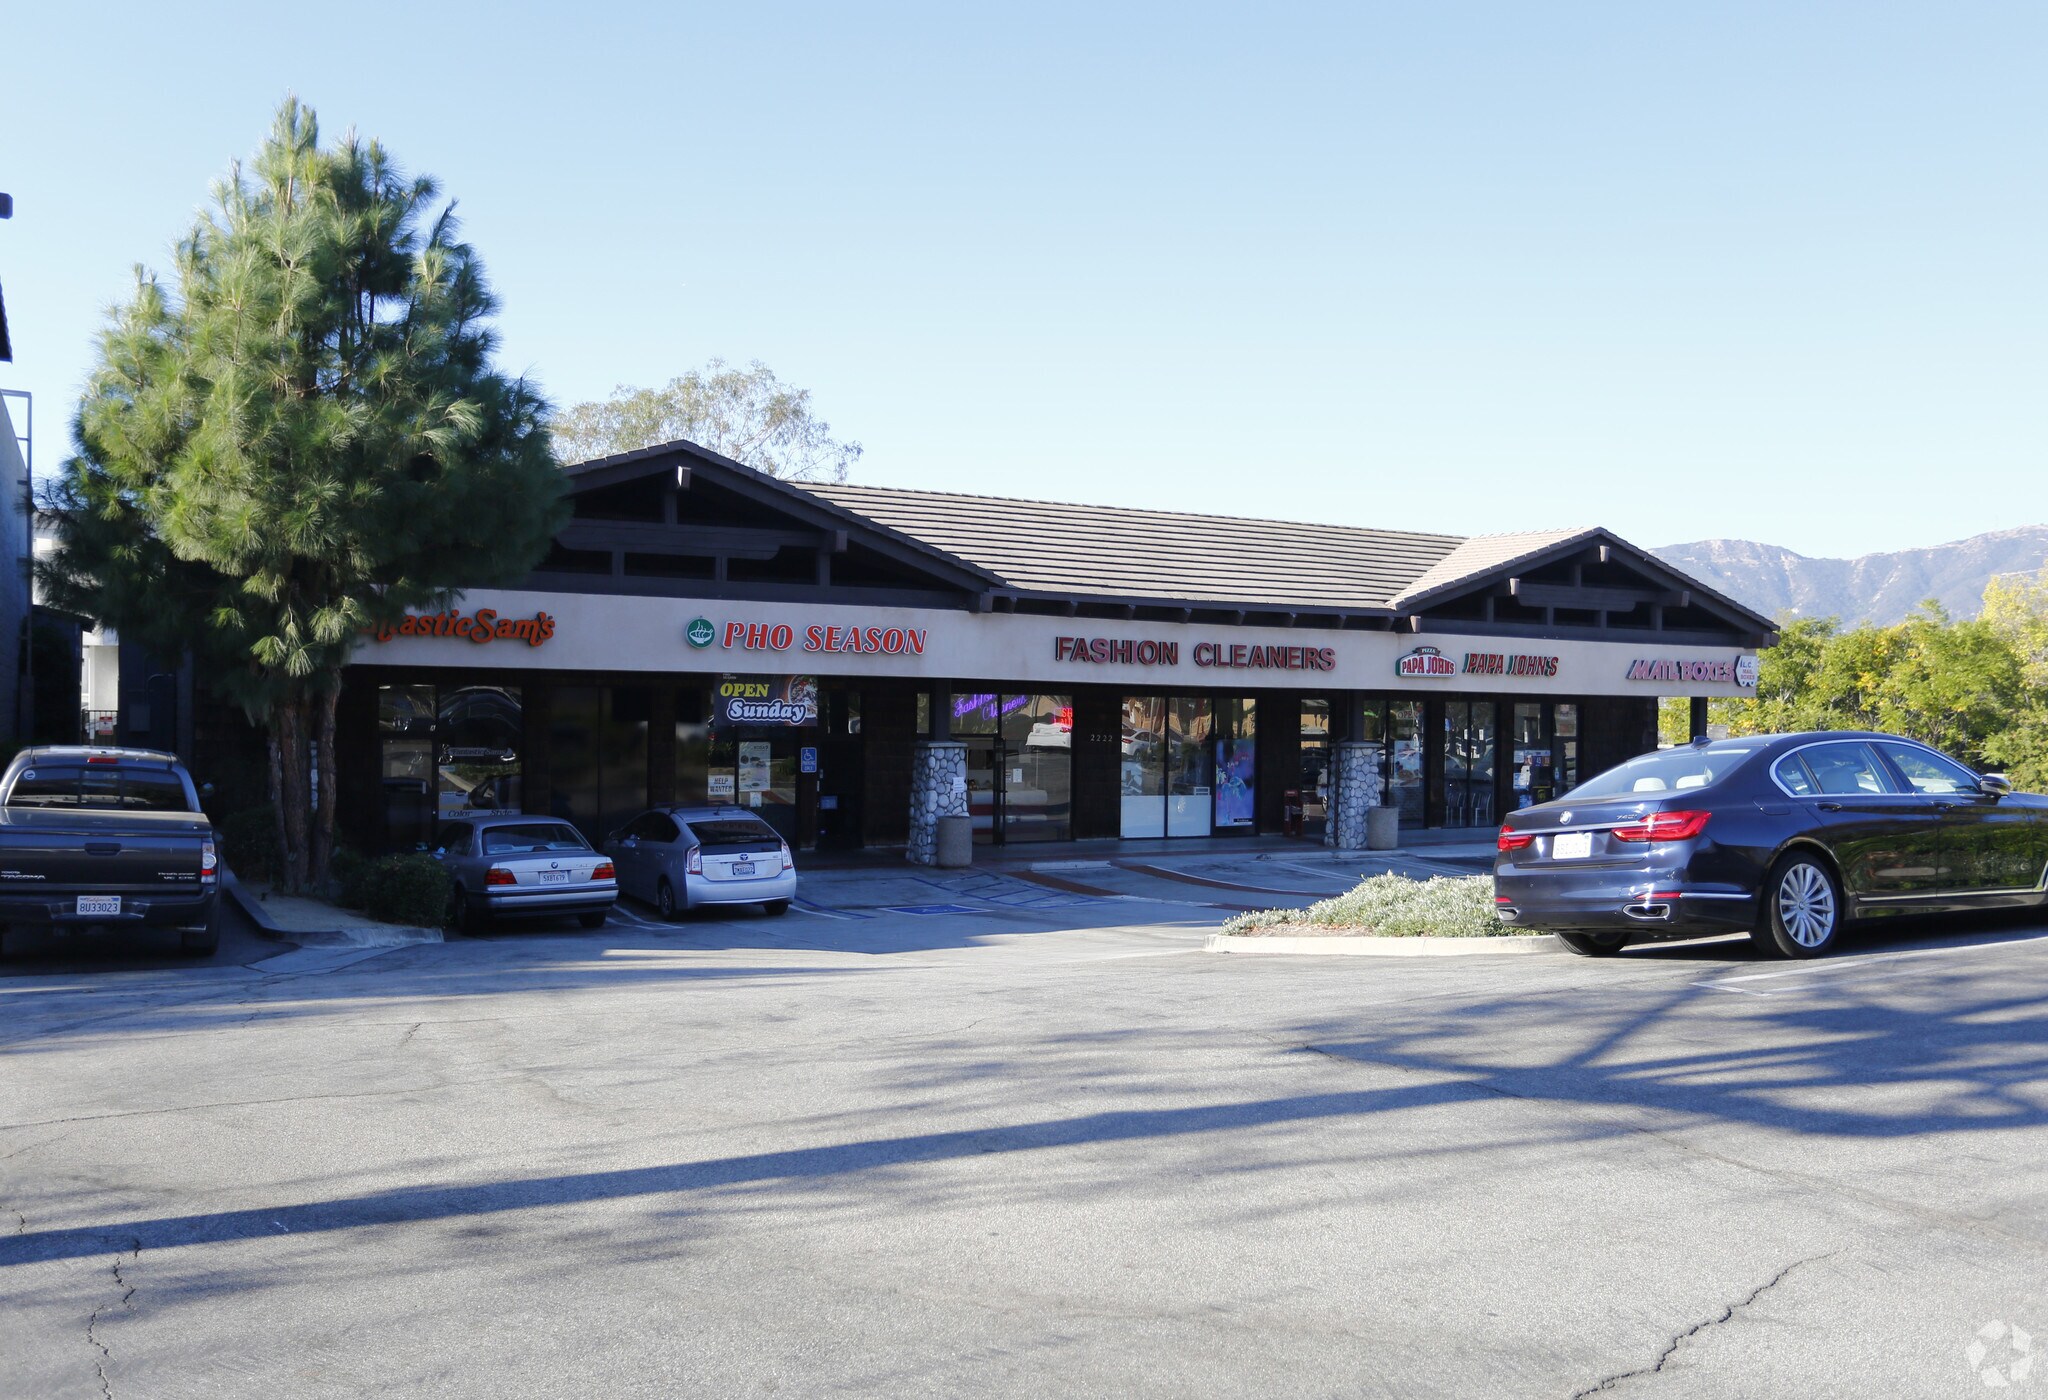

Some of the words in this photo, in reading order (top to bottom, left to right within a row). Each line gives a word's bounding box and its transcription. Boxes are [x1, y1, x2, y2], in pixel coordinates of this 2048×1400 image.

[722, 620, 794, 650] PHO
[803, 623, 928, 655] SEASON
[1055, 636, 1179, 665] FASHION
[1193, 642, 1336, 671] CLEANERS
[1402, 656, 1424, 674] PAPA
[1463, 653, 1504, 674] PAPA
[1627, 659, 1679, 681] MAIL
[1680, 660, 1736, 682] BOXES
[720, 682, 770, 698] OPEN
[728, 699, 806, 723] Sunday
[1090, 734, 1113, 742] 2222
[709, 785, 733, 793] WANTED
[714, 777, 729, 785] HELP
[448, 810, 473, 818] Color
[79, 902, 118, 913] 8U33023
